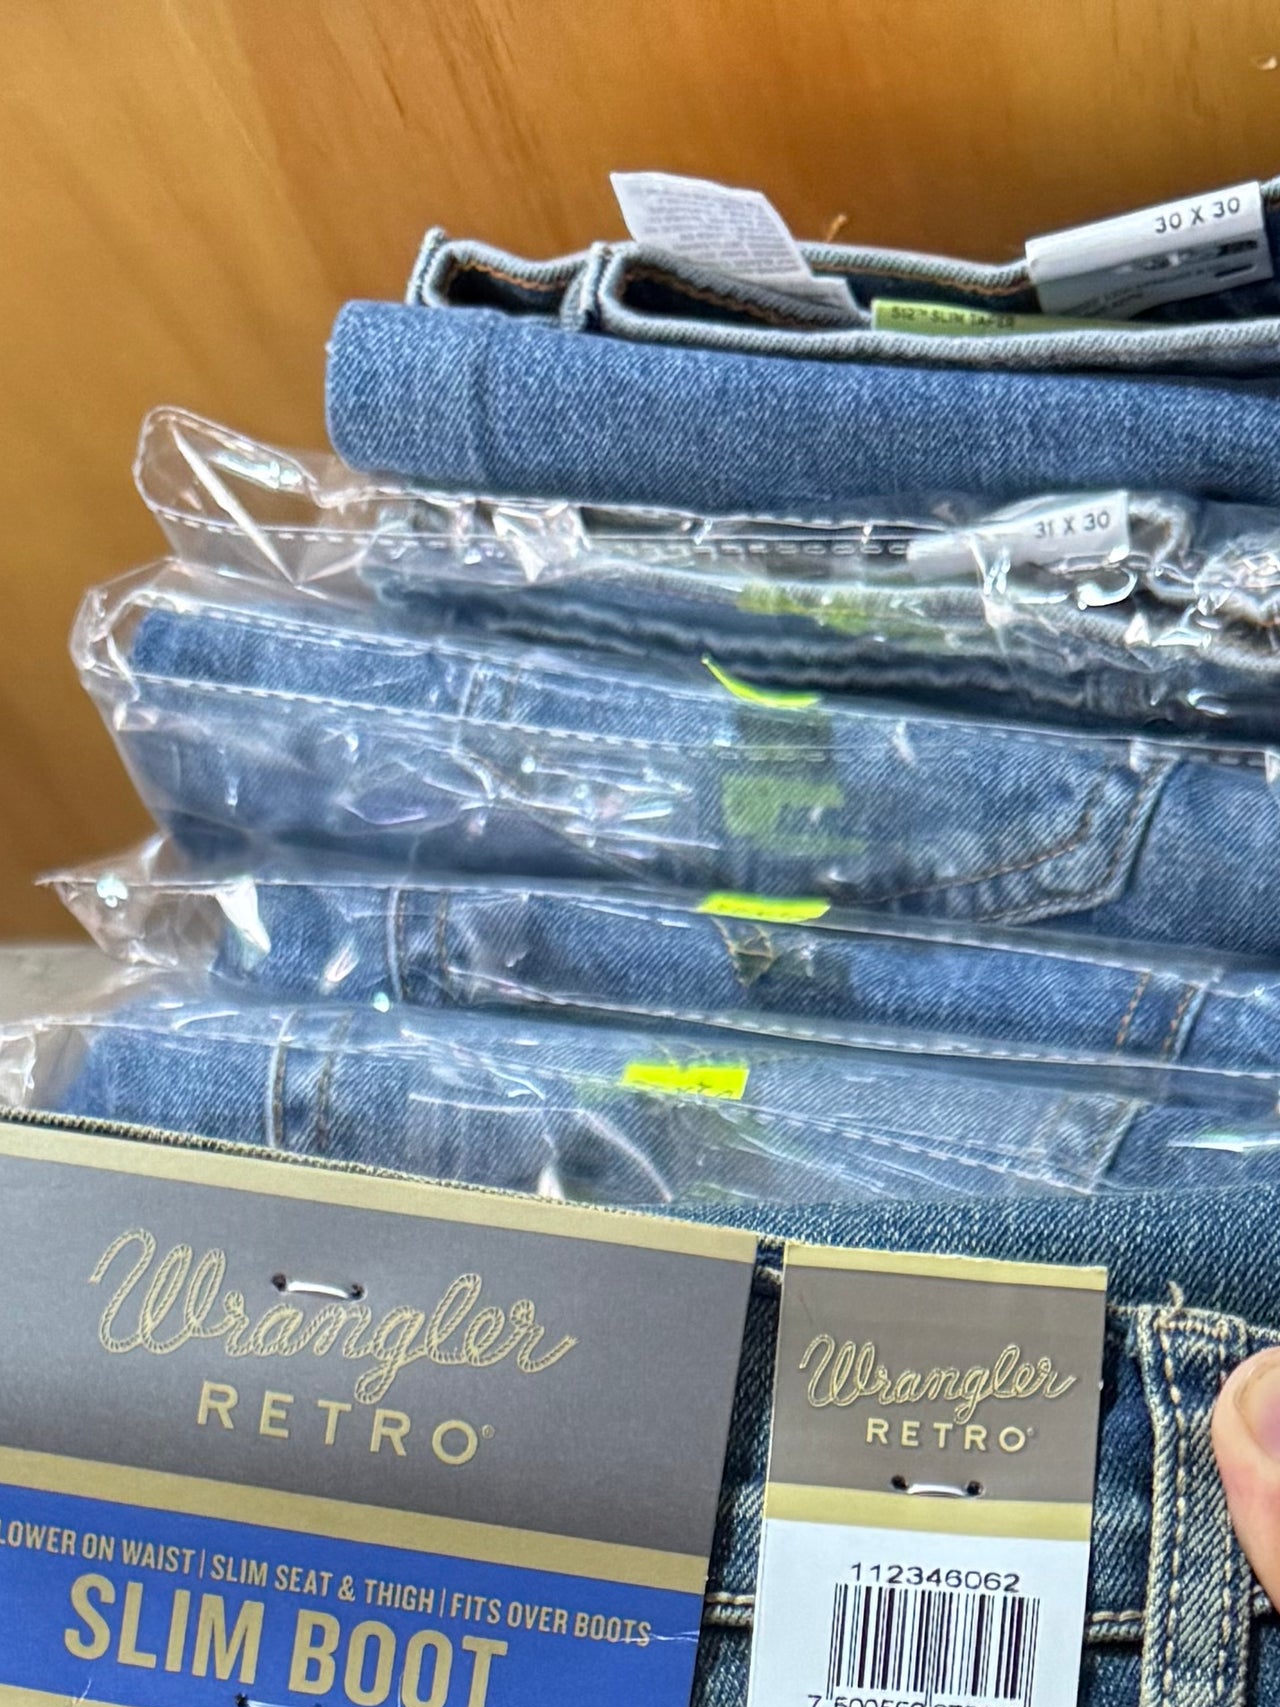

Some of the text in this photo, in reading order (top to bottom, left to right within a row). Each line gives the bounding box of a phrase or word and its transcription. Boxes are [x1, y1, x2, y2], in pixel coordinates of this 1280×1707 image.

[1154, 196, 1241, 234] 30 X 30
[1034, 509, 1111, 539] 31 X 30
[87, 1226, 581, 1405] Wrangler
[798, 1332, 1078, 1425] Wrangler
[81, 1531, 116, 1562] ON
[121, 1537, 197, 1576] WAIST
[209, 1553, 269, 1588] SLIM
[274, 1563, 333, 1598] SEAT
[337, 1574, 356, 1602] &
[363, 1577, 435, 1615] THIGH
[449, 1592, 503, 1625] FITS
[506, 1600, 569, 1636] OVER
[573, 1611, 652, 1648] BOOTS
[849, 1561, 1021, 1594] 112346062
[63, 1572, 266, 1686] SLIM
